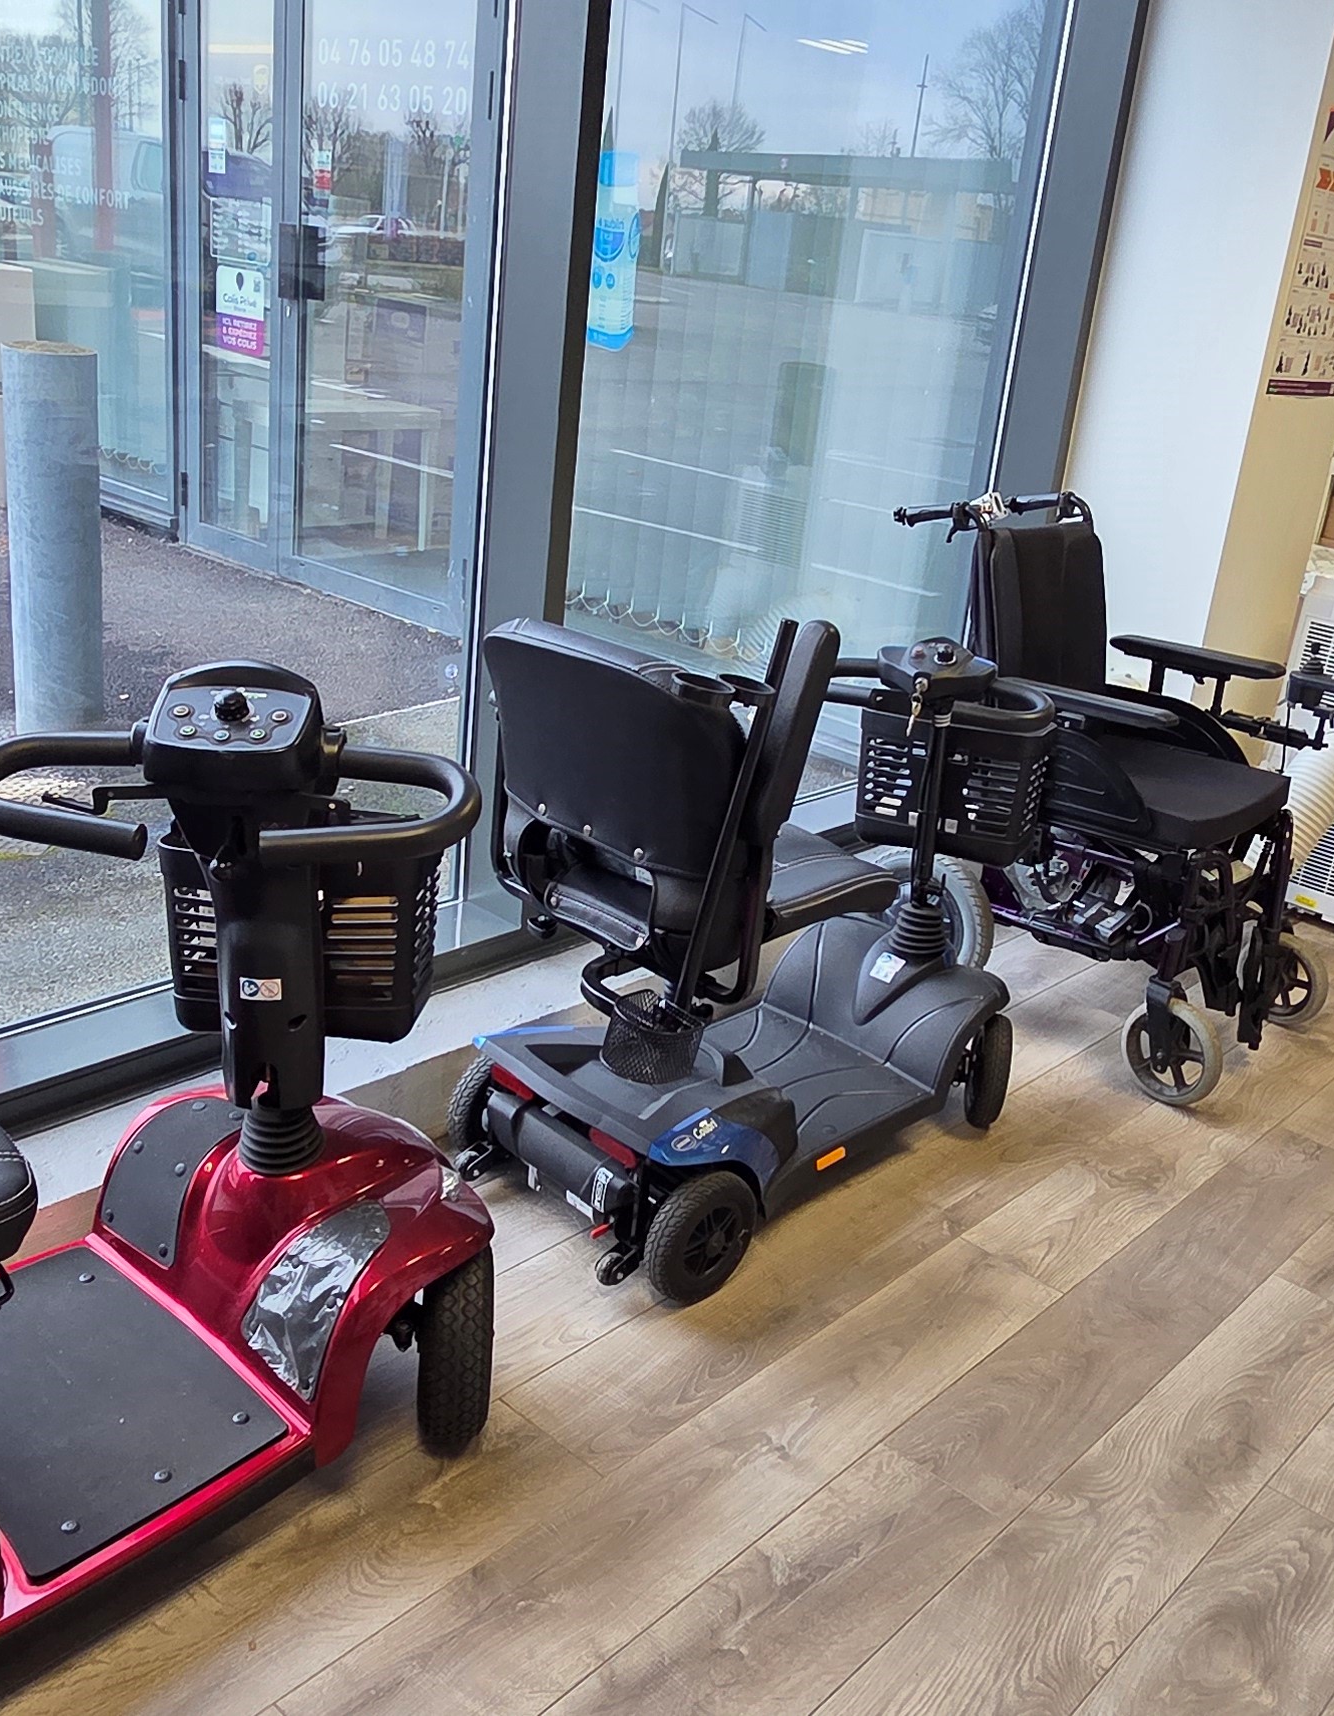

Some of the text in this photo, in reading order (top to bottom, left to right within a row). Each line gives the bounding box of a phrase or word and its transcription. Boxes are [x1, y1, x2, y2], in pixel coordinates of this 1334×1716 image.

[318, 38, 469, 69] 04 76 05 48 74
[318, 81, 467, 115] 06 21 63 05 20
[76, 185, 131, 211] CONFORT
